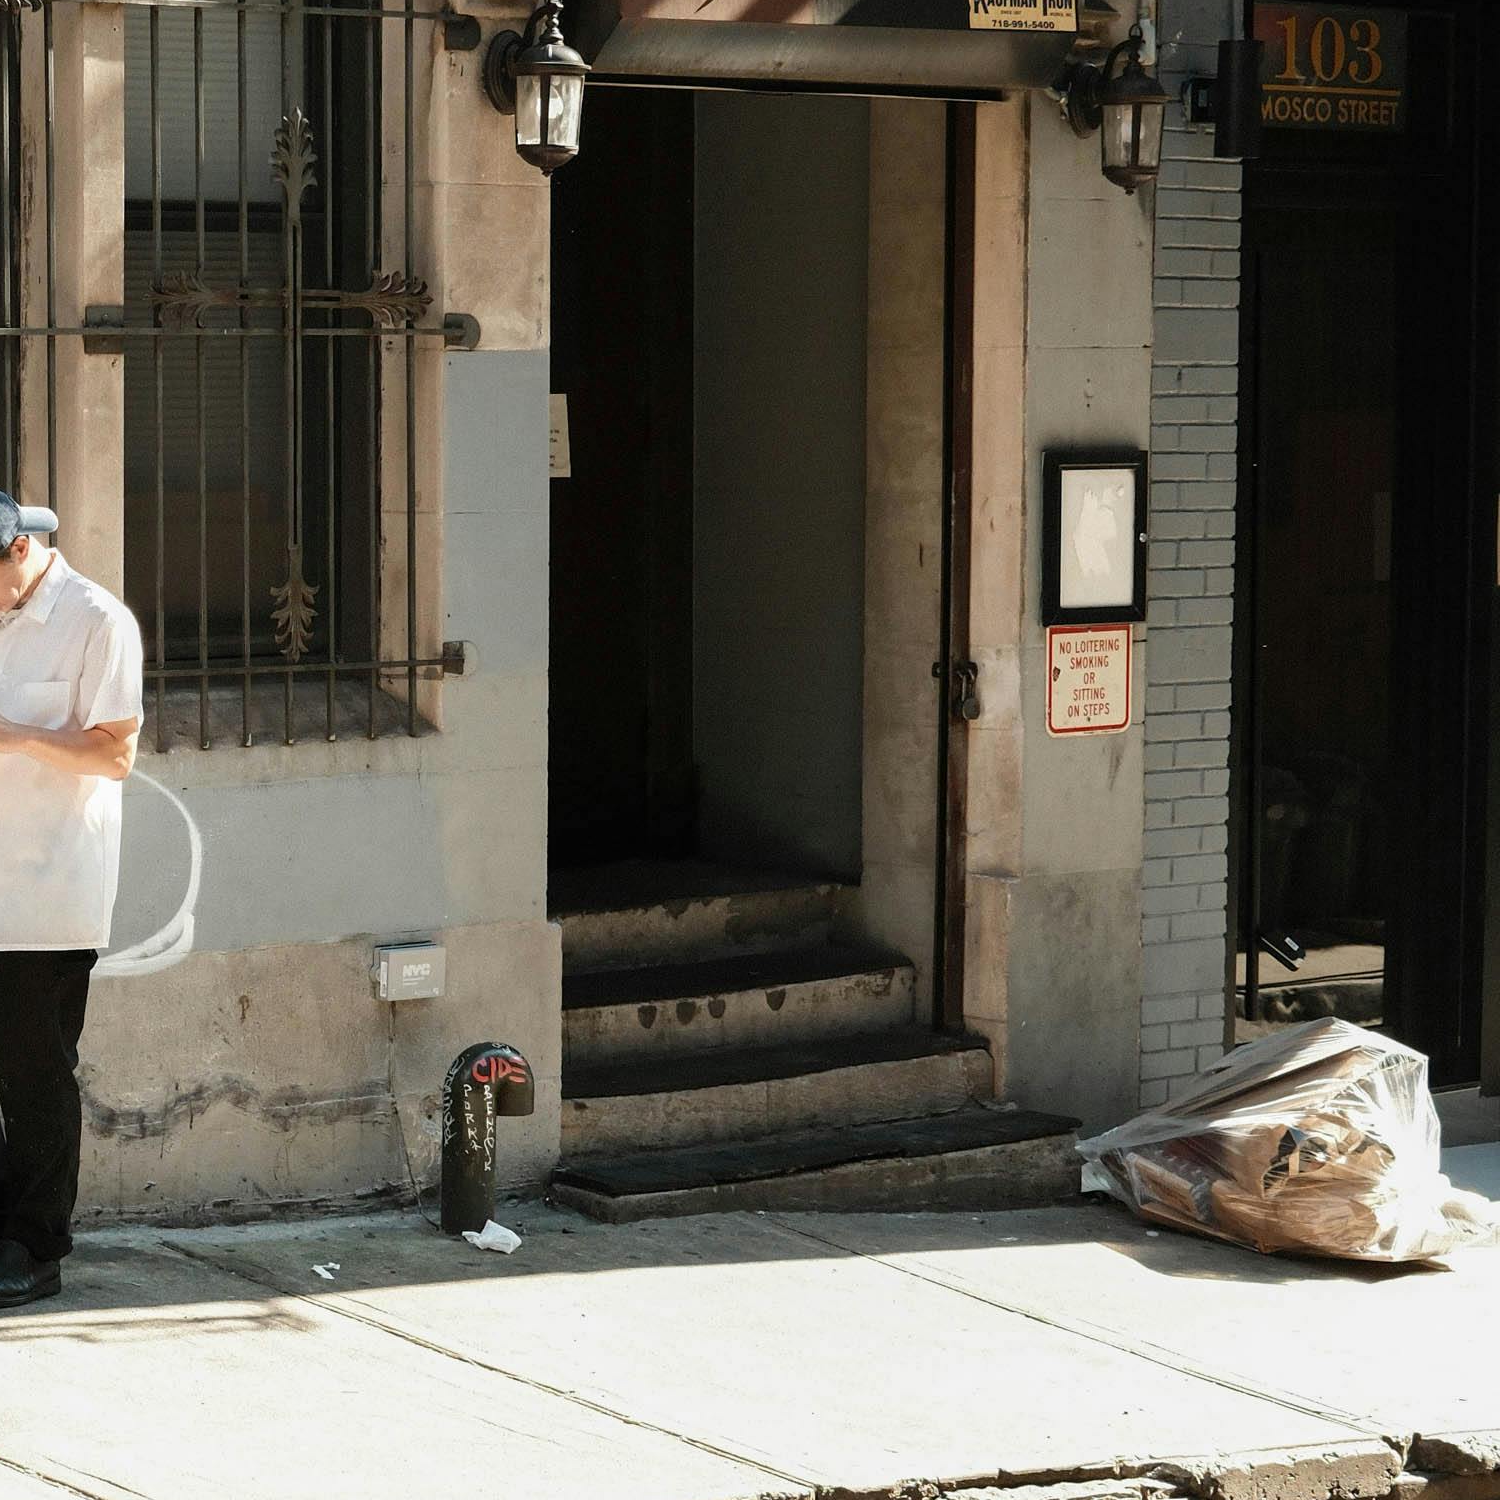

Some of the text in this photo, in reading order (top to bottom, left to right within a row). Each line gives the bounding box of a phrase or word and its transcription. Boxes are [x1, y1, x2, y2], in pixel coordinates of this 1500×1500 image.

[991, 19, 1056, 30] 718-991-5400
[1275, 16, 1383, 84] 103
[1337, 101, 1399, 125] STREET
[1059, 638, 1120, 654] NO LOITERING
[1070, 655, 1109, 670] SMOKING
[1083, 672, 1096, 685] OR
[1073, 687, 1106, 701] SITTING
[1067, 703, 1110, 718] ON STEPS
